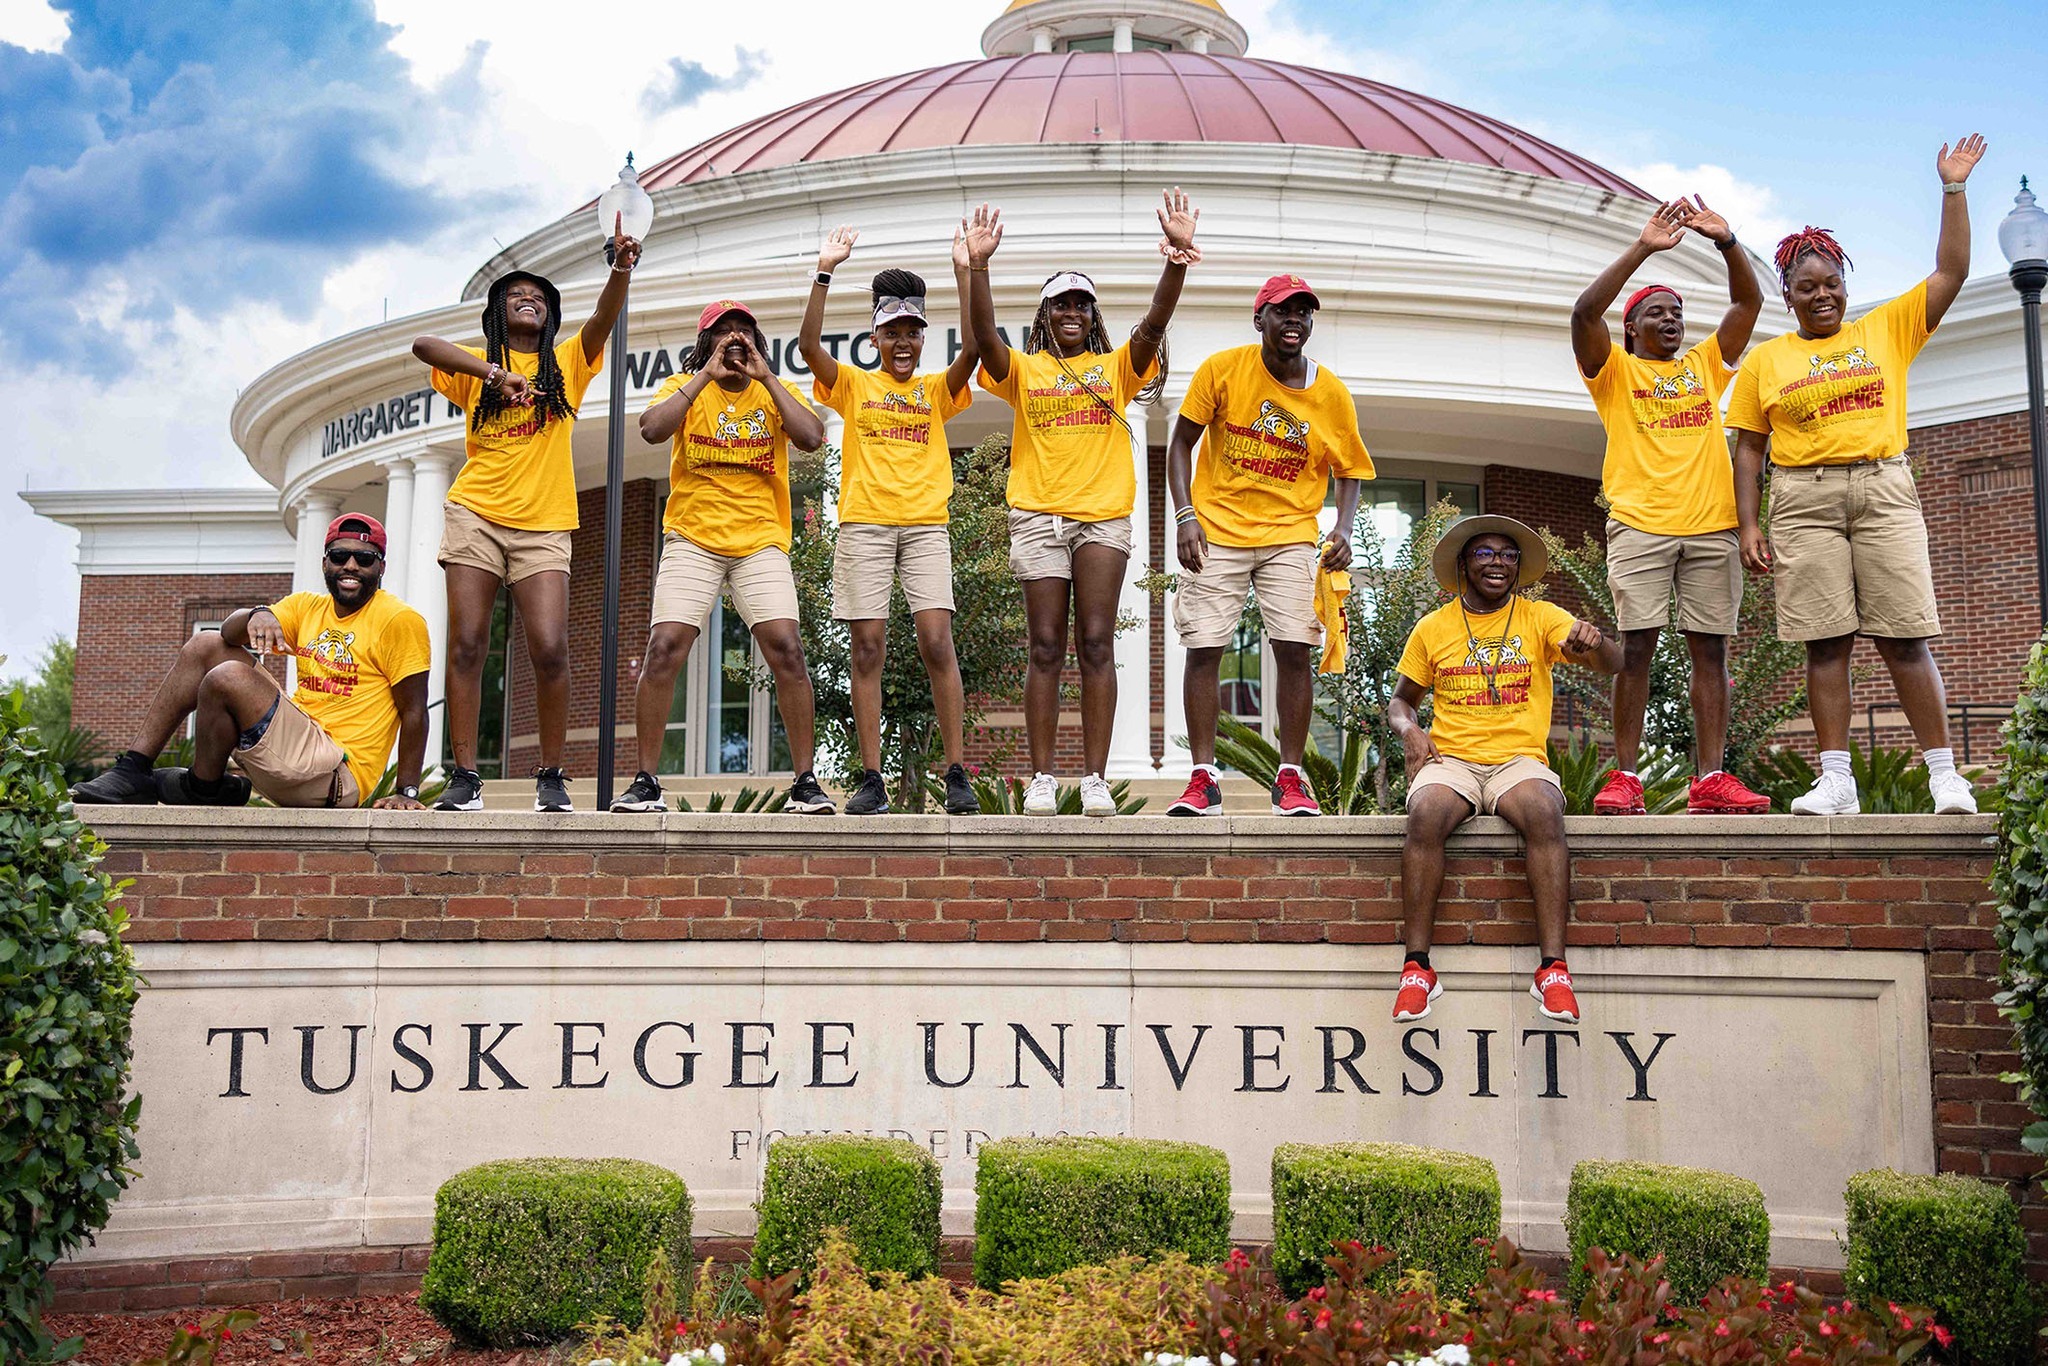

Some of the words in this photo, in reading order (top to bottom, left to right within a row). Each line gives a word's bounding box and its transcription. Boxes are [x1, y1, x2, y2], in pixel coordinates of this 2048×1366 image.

[1779, 374, 1827, 397] TUSKEGEE
[1829, 366, 1882, 382] UNIVERSITY
[1780, 380, 1838, 413] GOLDEN
[1843, 377, 1885, 395] TIGER
[322, 388, 437, 458] MARGARET
[1787, 391, 1884, 424] EXPERIENCE
[685, 443, 738, 462] GOLDEN
[741, 447, 775, 463] TIGER
[689, 434, 729, 448] TUSKEGEE
[731, 436, 774, 448] UNIVERSITY
[1224, 431, 1269, 458] GOLDEN
[1270, 446, 1308, 470] TIGER
[1225, 421, 1262, 441] TUSKEGEE
[1263, 434, 1310, 458] UNIVERSITY
[1221, 446, 1300, 483] EXPERIENCE
[314, 653, 360, 673] UNIVERSITY
[1439, 665, 1479, 679] TUSKEGEE
[1440, 676, 1489, 691] GOLDEN
[207, 1022, 859, 1097] TUSKEGEE
[916, 1022, 1677, 1102] UNIVERSITY
